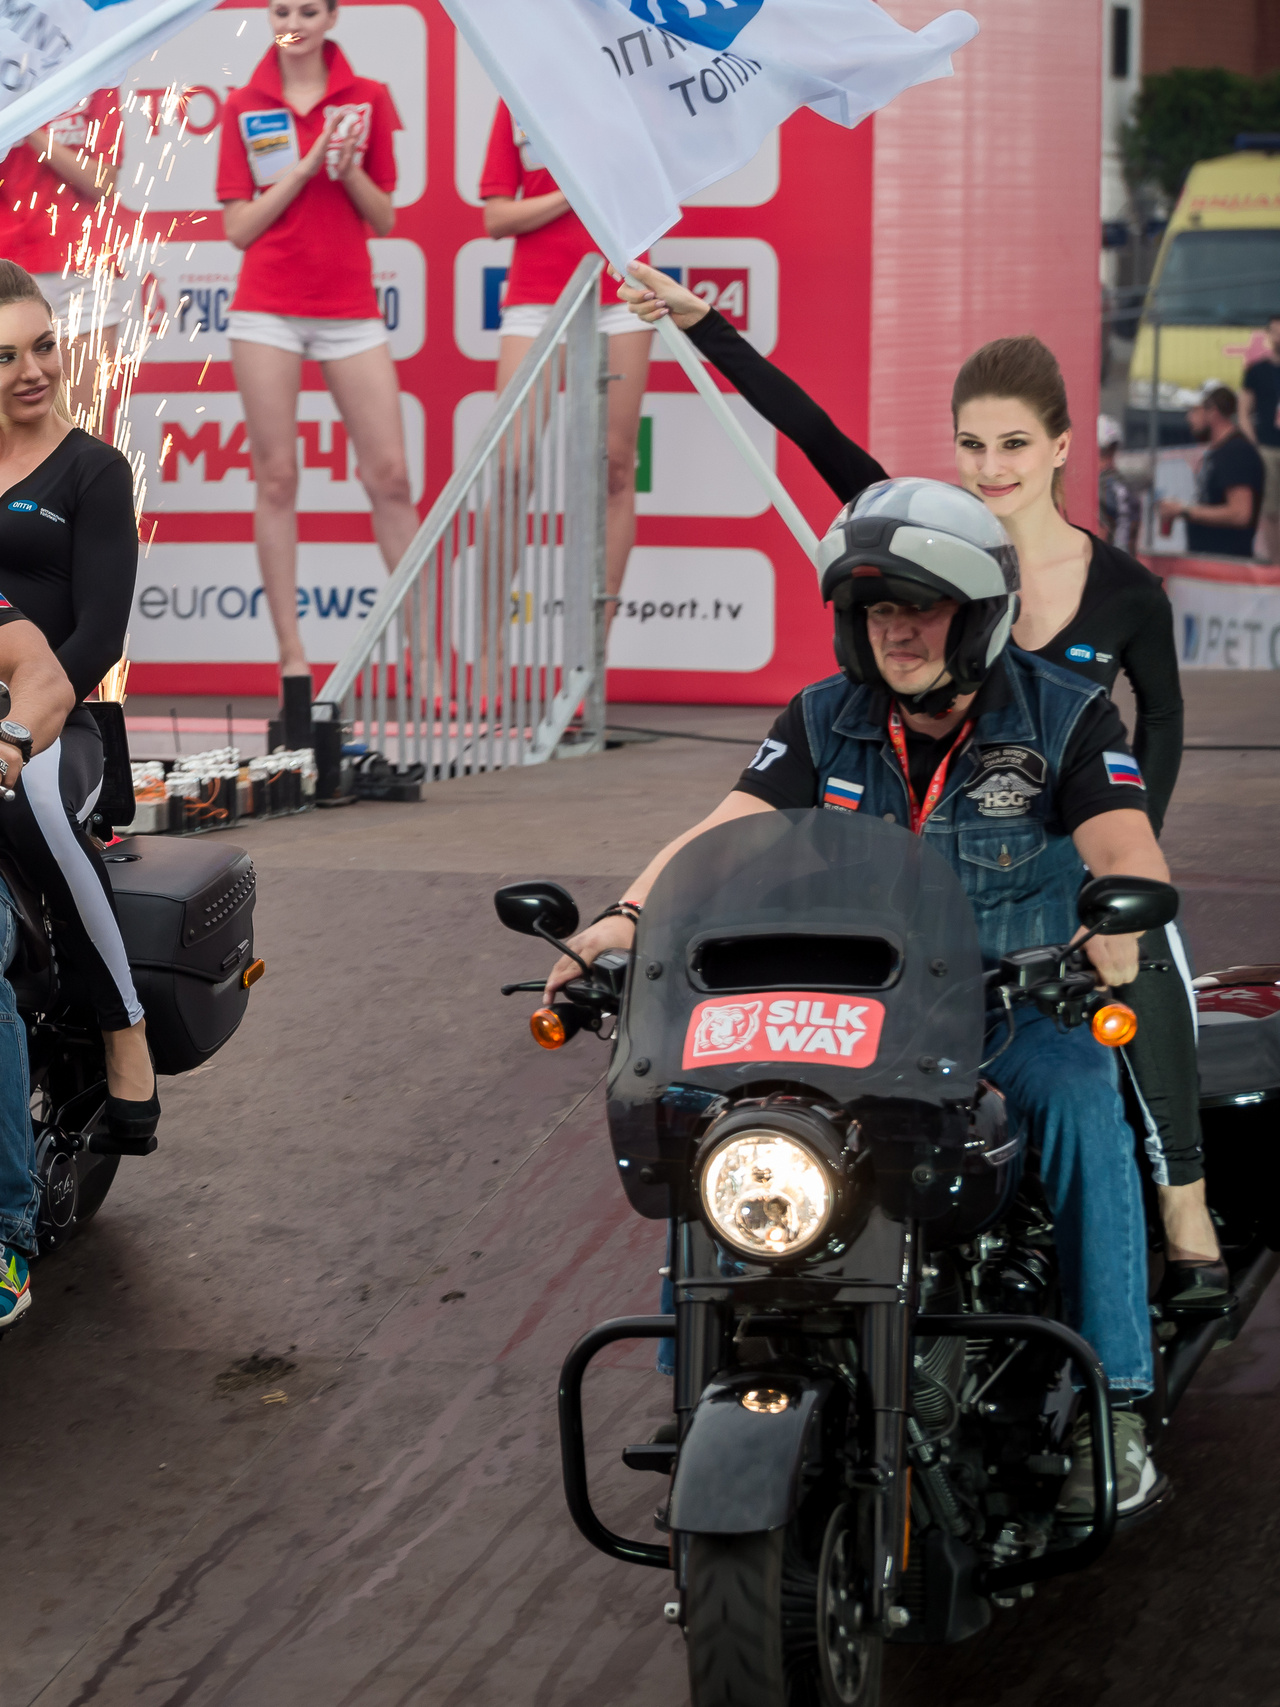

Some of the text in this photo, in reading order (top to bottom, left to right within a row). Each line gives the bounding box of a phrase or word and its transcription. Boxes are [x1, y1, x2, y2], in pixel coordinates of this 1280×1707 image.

[984, 756, 1023, 768] CHAPTER
[765, 1000, 870, 1030] SILK
[764, 1025, 867, 1057] WAY
